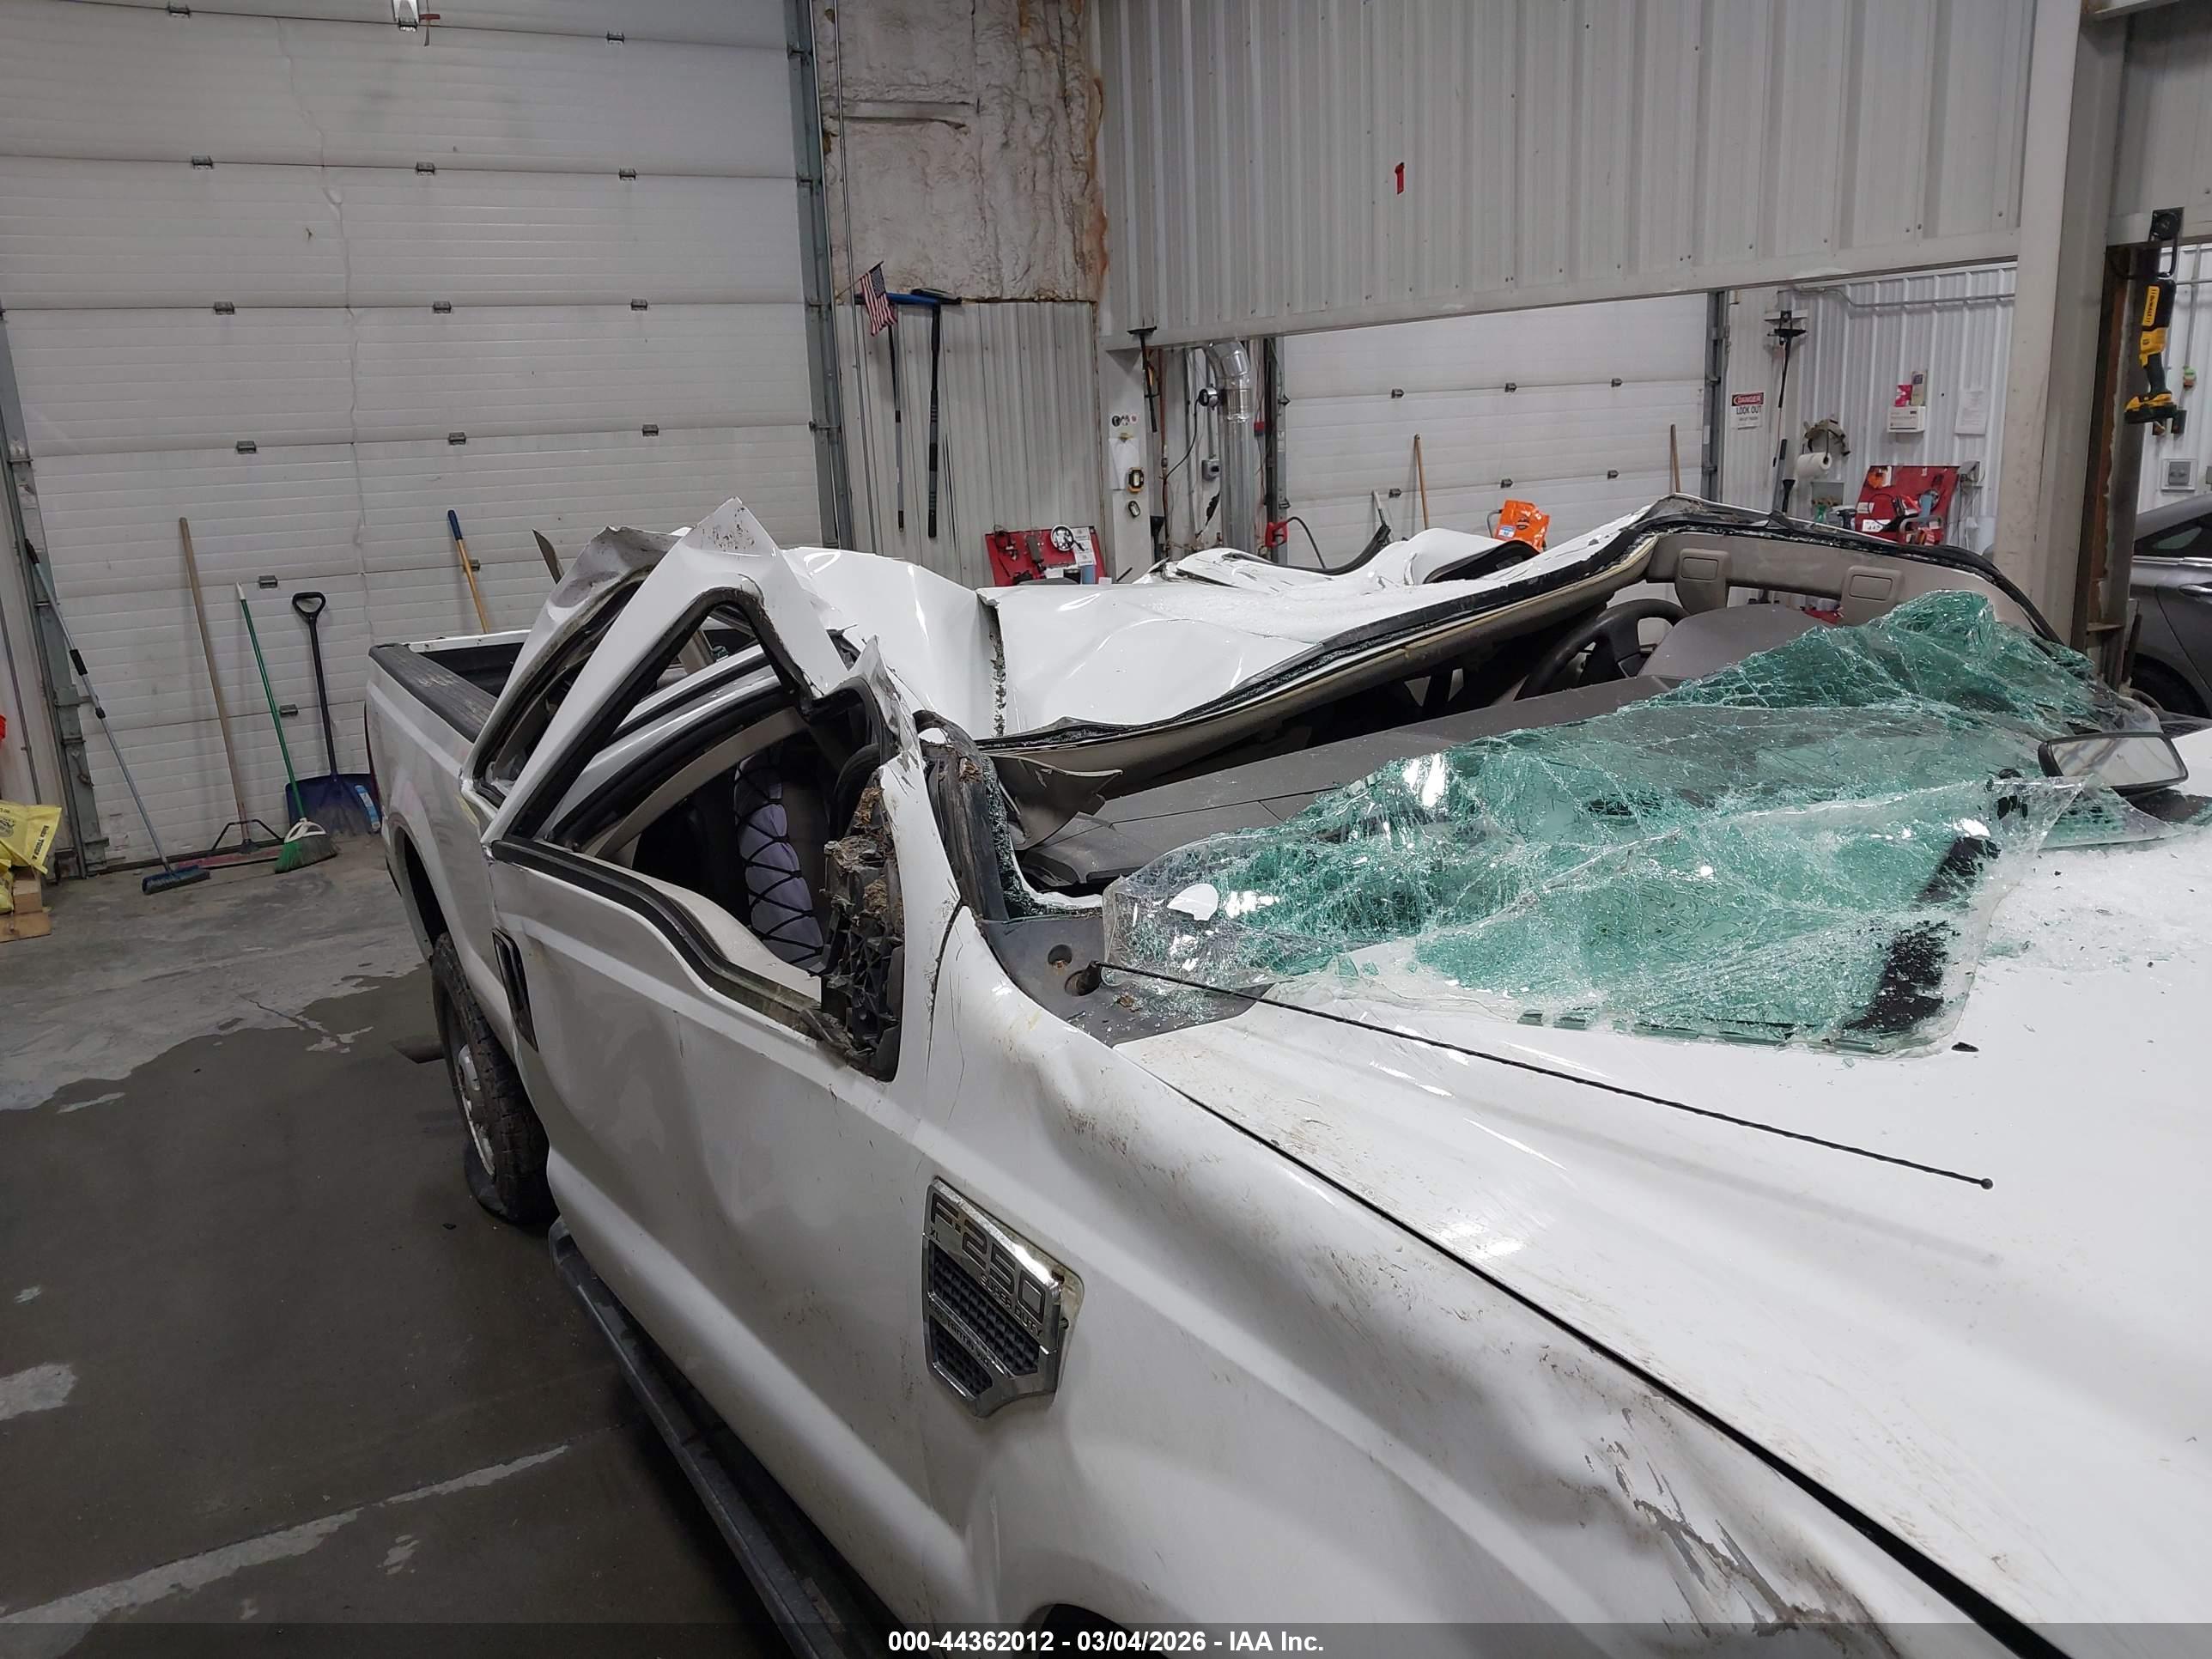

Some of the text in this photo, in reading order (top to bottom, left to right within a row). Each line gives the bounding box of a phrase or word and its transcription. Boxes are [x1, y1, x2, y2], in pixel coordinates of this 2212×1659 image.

[930, 1226, 942, 1243] XL
[980, 1273, 1012, 1310] SUPER
[1014, 1307, 1042, 1337] DUTY
